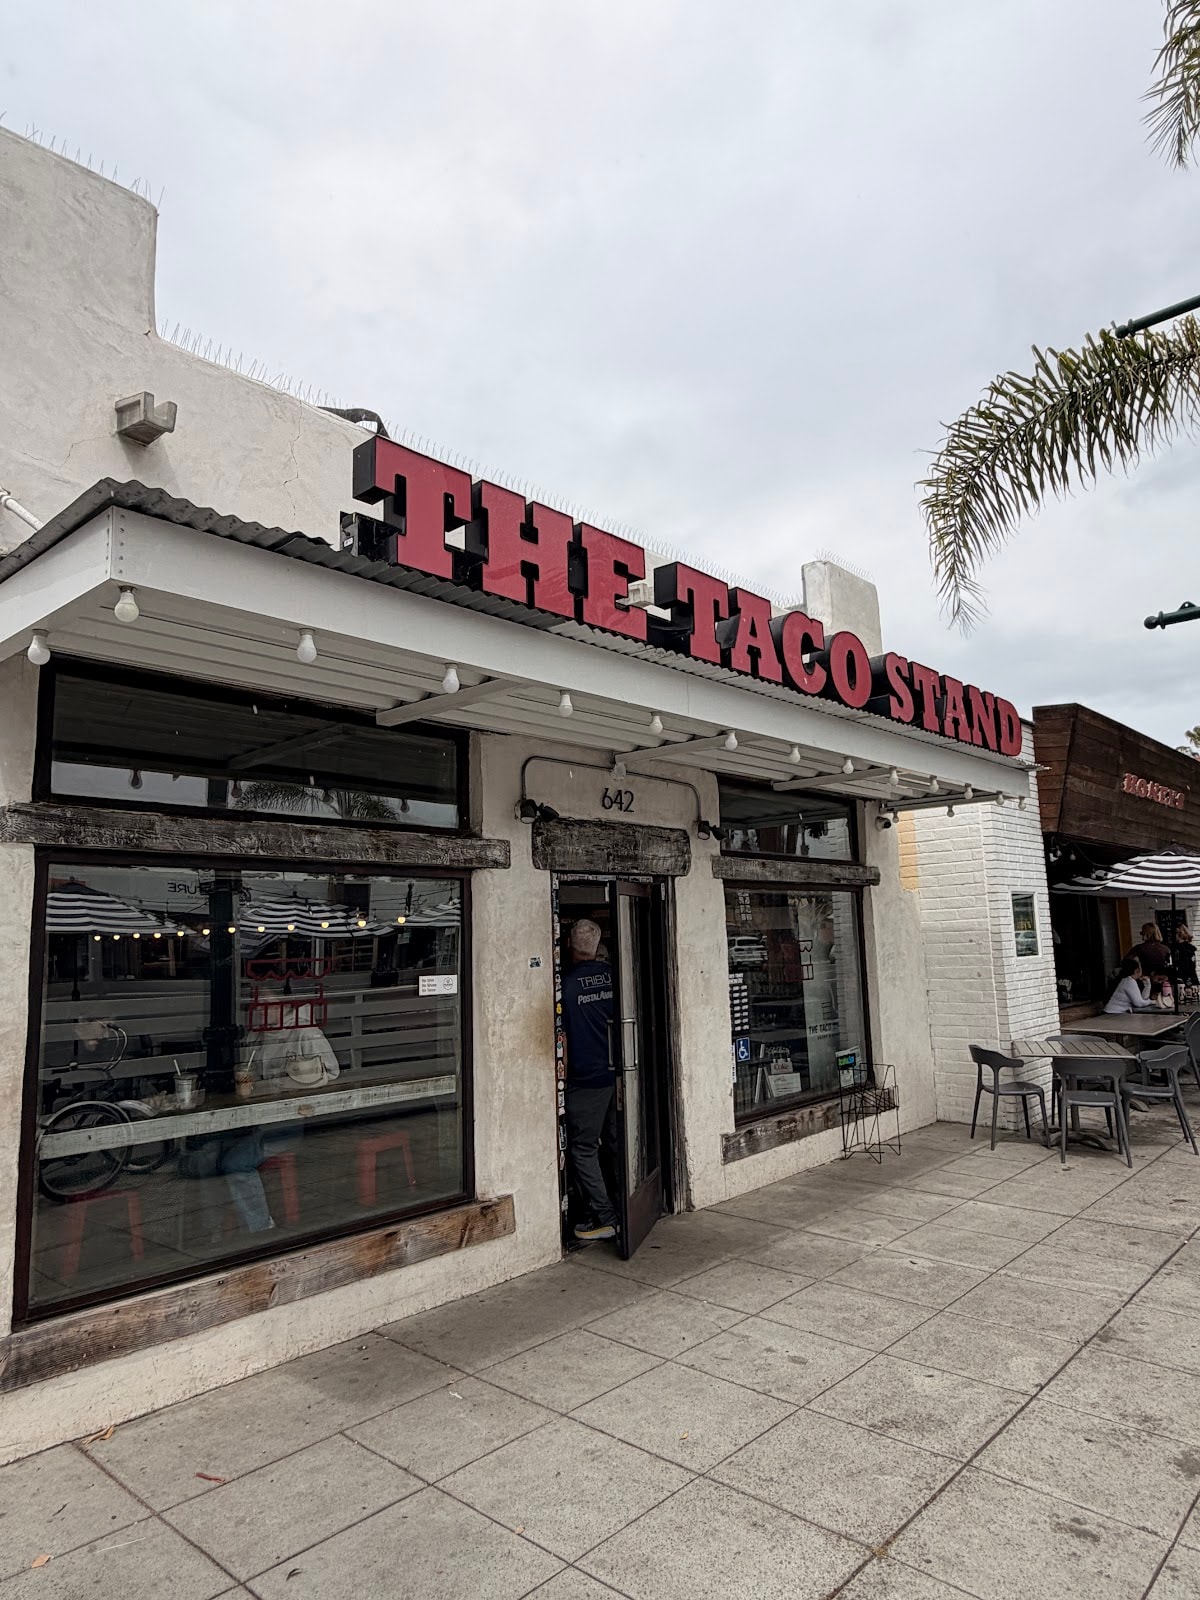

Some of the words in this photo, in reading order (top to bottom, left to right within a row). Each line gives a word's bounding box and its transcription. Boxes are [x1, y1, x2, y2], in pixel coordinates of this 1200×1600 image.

[366, 434, 648, 642] THE
[672, 561, 873, 709] TACO
[884, 651, 1023, 757] STAND
[601, 787, 635, 812] 642
